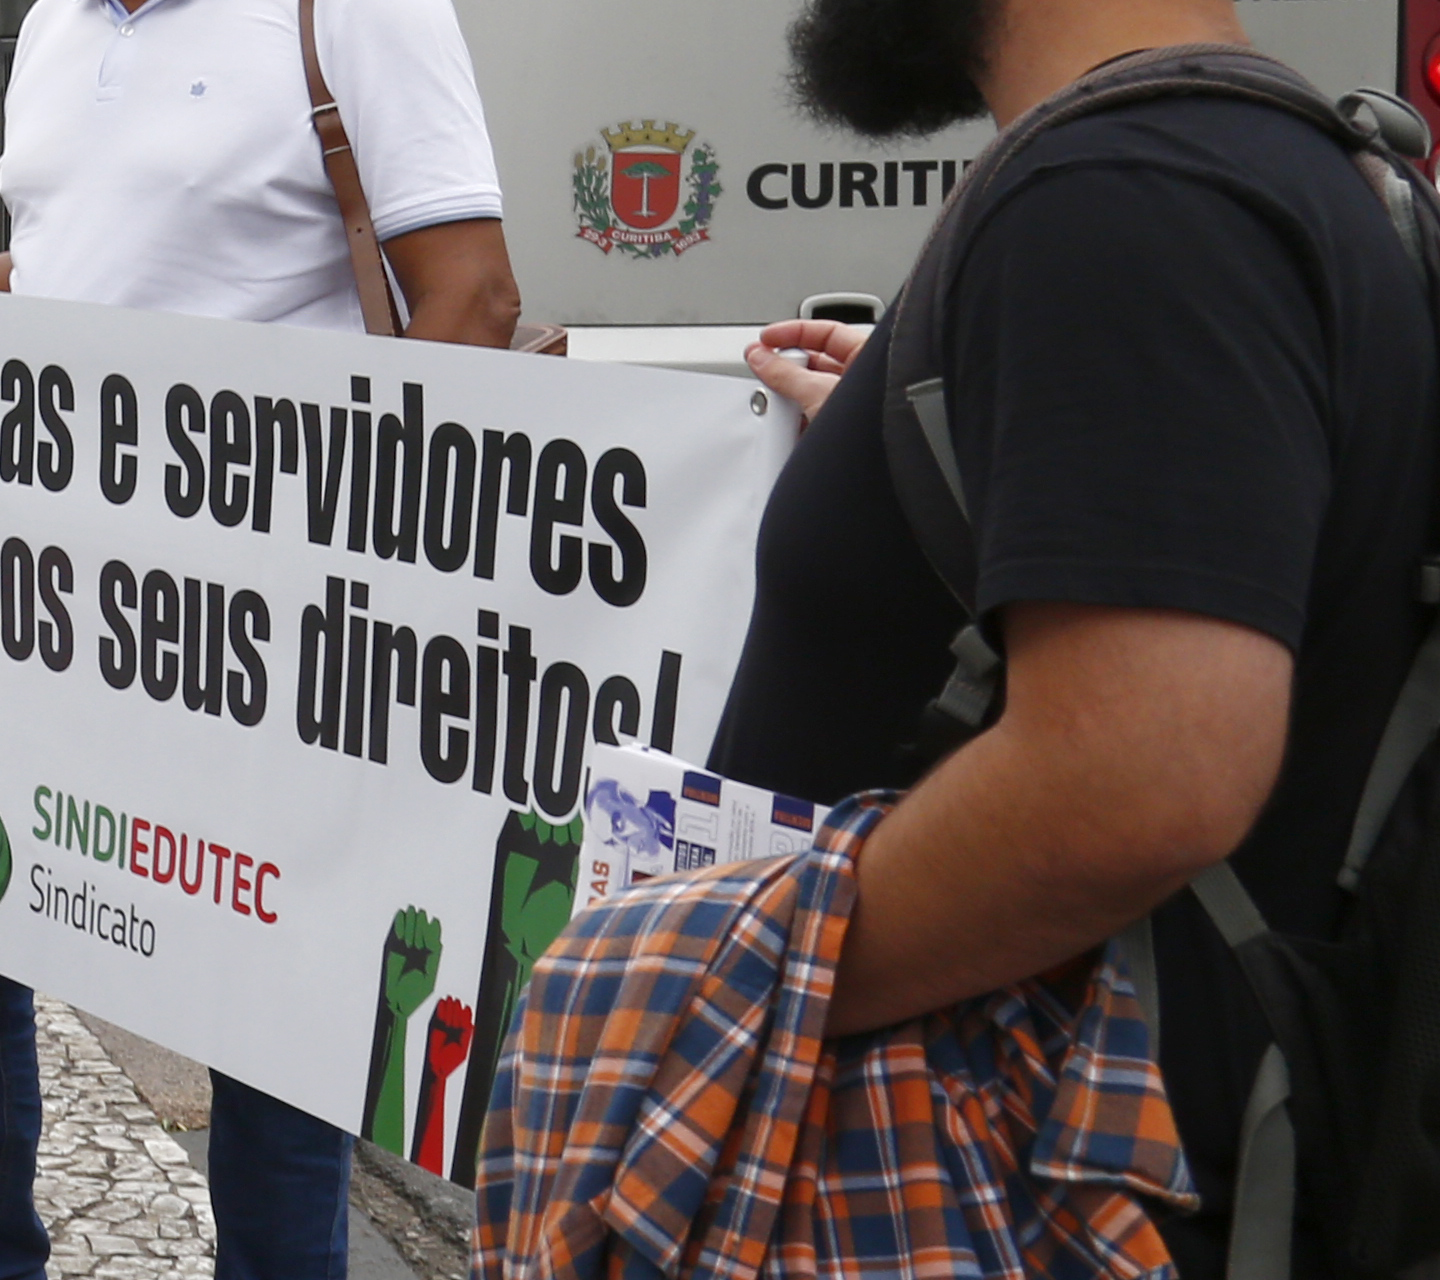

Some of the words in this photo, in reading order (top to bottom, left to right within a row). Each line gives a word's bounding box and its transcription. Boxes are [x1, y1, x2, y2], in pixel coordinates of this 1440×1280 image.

[611, 230, 673, 244] CURITIBA
[746, 159, 973, 210] CURITI
[99, 371, 138, 506] e
[163, 374, 649, 609] servidores
[98, 557, 271, 728] seus
[28, 863, 158, 959] Sindicato
[33, 784, 281, 926] SINDIEDUTEC
